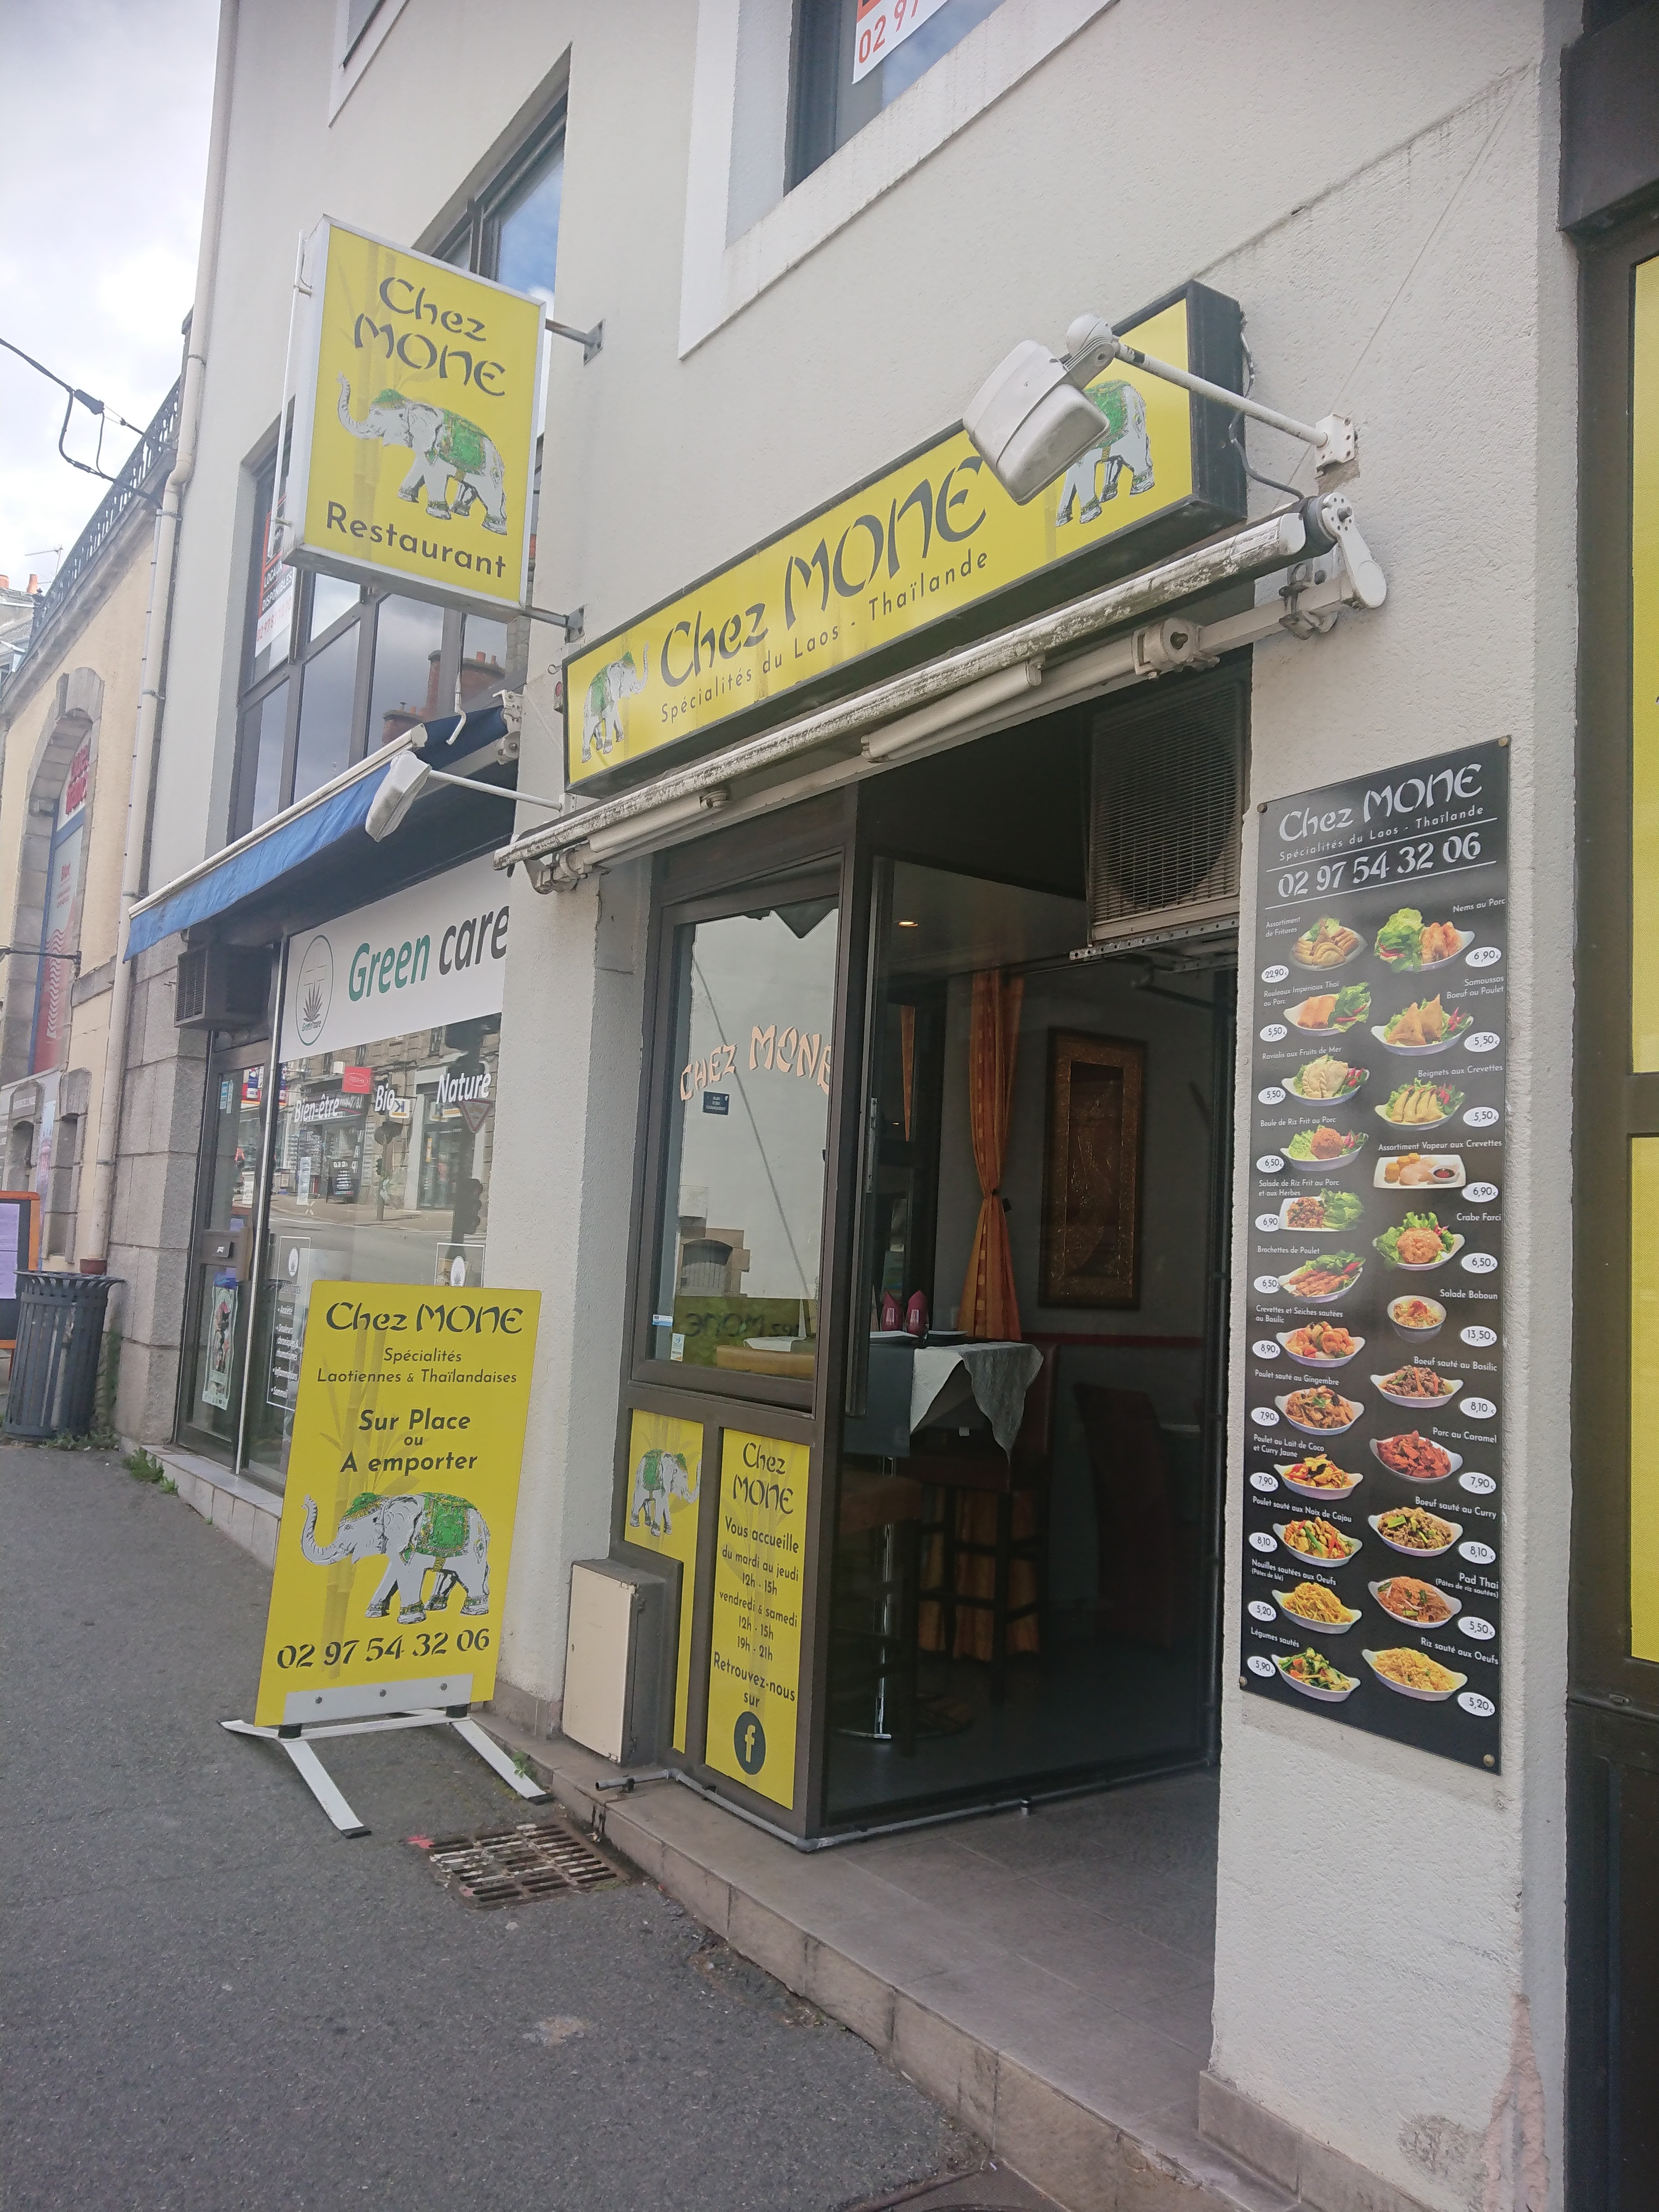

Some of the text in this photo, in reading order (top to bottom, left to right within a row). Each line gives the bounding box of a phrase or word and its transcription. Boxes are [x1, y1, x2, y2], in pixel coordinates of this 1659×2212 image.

[858, 14, 887, 63] 02
[379, 277, 486, 341] Chez
[354, 313, 505, 396] MONE
[326, 500, 507, 578] Restaurant
[661, 455, 987, 687] Chez MONE
[662, 550, 988, 724] Spécialités du Laos Thaïlande
[1279, 763, 1482, 841] Chez MONE
[1280, 805, 1483, 861] Spécialités du Laos Thaïlande
[1278, 832, 1481, 898] 02 97 54 32 06
[1452, 898, 1506, 913] Nems Porc
[1266, 917, 1301, 928] Assortiment
[1274, 927, 1298, 936] Fritures
[349, 905, 510, 1002] Green care
[1264, 988, 1291, 998] Rouleaux
[1292, 984, 1323, 994] Impériaux
[1447, 985, 1505, 999] Boeuf Poulet
[1464, 976, 1505, 986] Samoussas
[302, 1022, 312, 1032] Green
[1262, 1051, 1284, 1060] Raviolis
[680, 1043, 738, 1102] CHEZ
[1418, 1064, 1503, 1078] Beignets Crevettes
[374, 1084, 395, 1112] Bio
[437, 1072, 492, 1105] Nature
[294, 1093, 340, 1123] Bien-être
[1378, 1143, 1419, 1151] Assortiment
[1422, 1141, 1448, 1151] Vapeur
[1456, 1213, 1502, 1221] Crabe Farci
[1440, 1289, 1498, 1300] Salade Boboun
[326, 1302, 524, 1334] Chez MONE
[1256, 1305, 1284, 1313] Crevettes
[1294, 1307, 1316, 1316] Seiches
[383, 1347, 462, 1365] Spécialités
[1414, 1356, 1435, 1365] Boeuf
[1473, 1362, 1498, 1371] Basilic
[317, 1368, 517, 1383] Laotiennes & Thaïlandaises
[1255, 1369, 1274, 1378] Poulet
[1304, 1375, 1339, 1386] Gingembre
[358, 1407, 471, 1431] Sur Place
[403, 1435, 424, 1446] ou
[1253, 1434, 1324, 1452] Poulet Lait Coco
[1432, 1427, 1497, 1443] Porc Caramel
[340, 1451, 478, 1476] A emporter
[743, 1442, 786, 1475] Chez
[1261, 1446, 1298, 1458] Curry Jaune
[732, 1474, 794, 1515] MONE
[1253, 1496, 1352, 1522] Poulet sauté Noix Cajou
[1415, 1496, 1497, 1520] Boeuf sauté Curry
[725, 1515, 799, 1554] Vous accueille
[722, 1544, 799, 1582] du mardi au jeudi
[1252, 1558, 1337, 1586] Nouilles sautées Oeufs
[742, 1572, 777, 1596] 12h 15h
[1459, 1572, 1477, 1585] Pad
[1474, 1588, 1499, 1599] sautées)
[719, 1590, 798, 1628] vendredi & samedi
[738, 1615, 774, 1641] 12h 15h
[1250, 1627, 1300, 1648] Légumes sautés
[277, 1628, 490, 1669] 02 97 54 32 06
[737, 1635, 774, 1662] 19h 21h
[1421, 1637, 1498, 1665] Riz sauté Oeufs
[713, 1651, 795, 1702] Retrouvez-nous
[744, 1692, 760, 1708] sur
